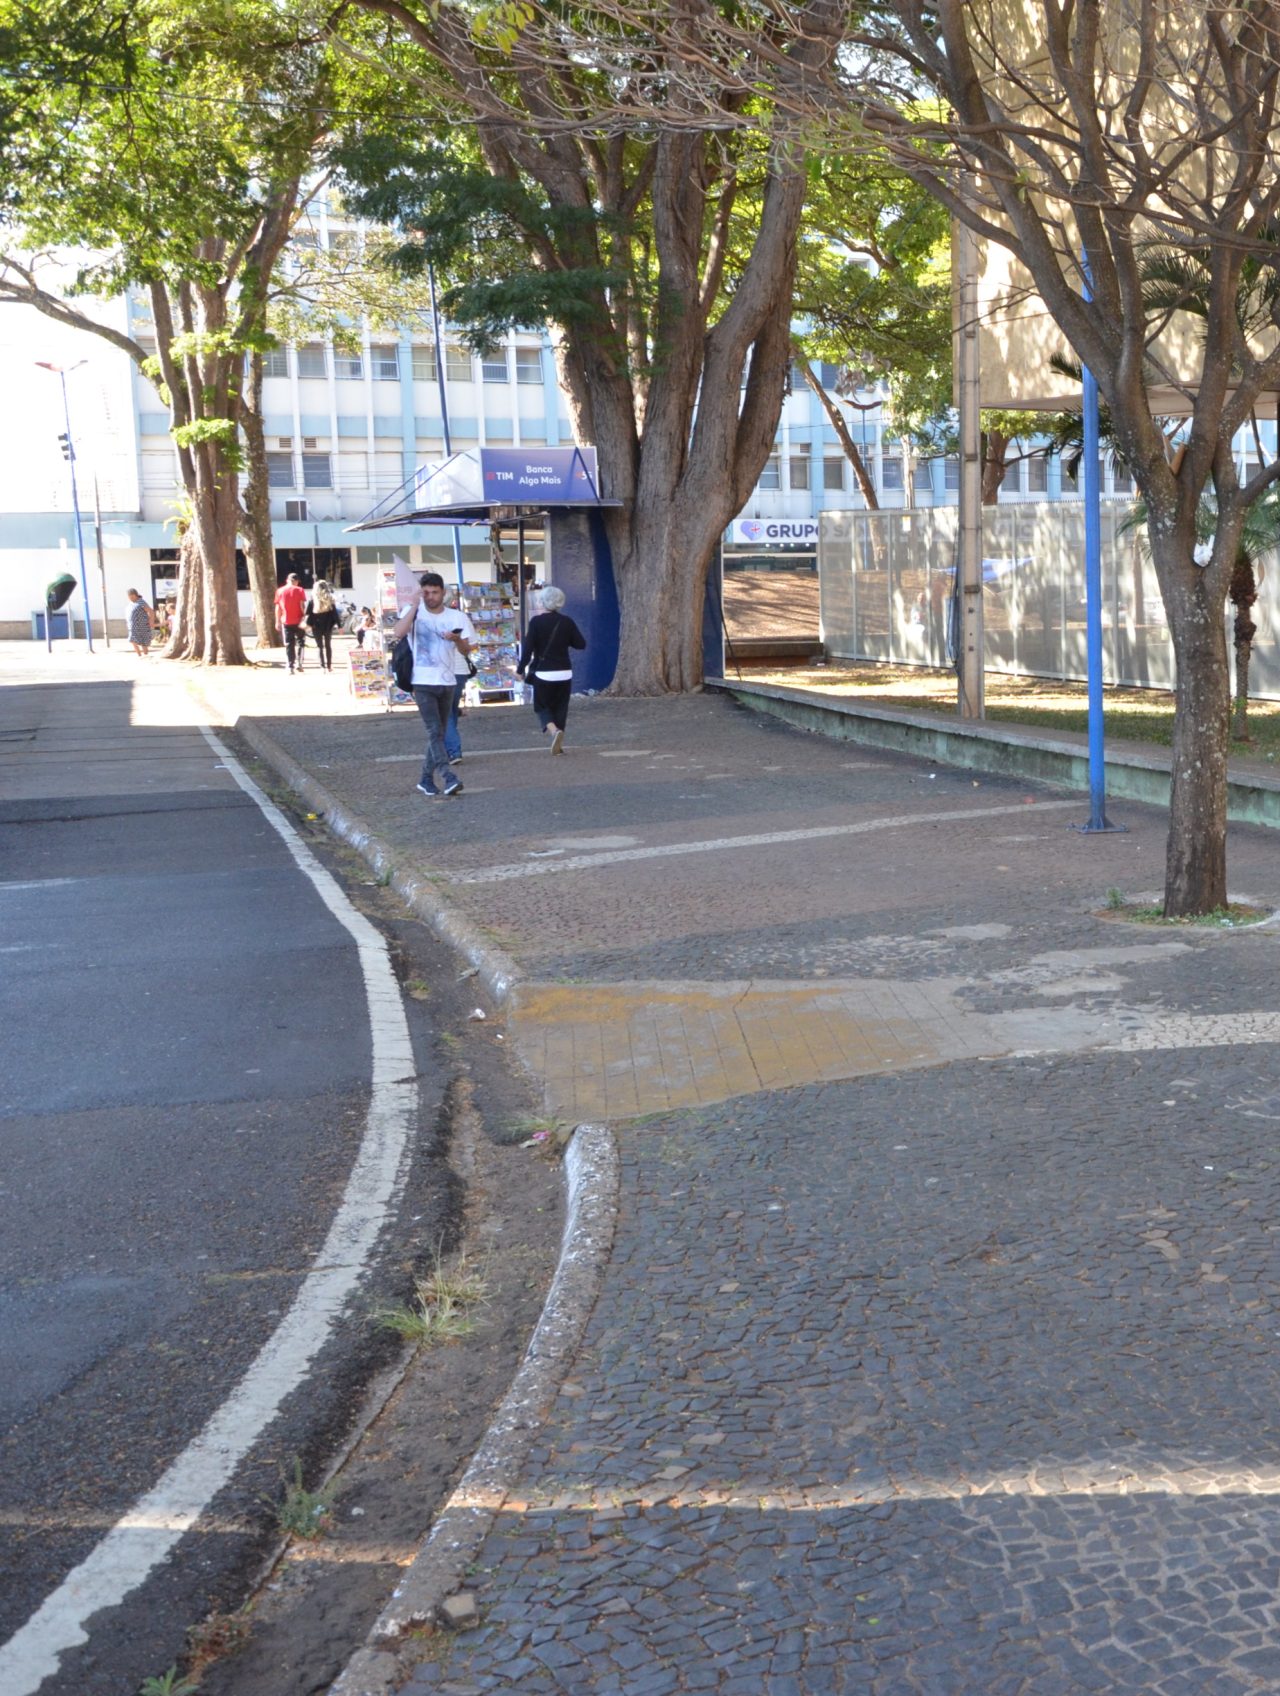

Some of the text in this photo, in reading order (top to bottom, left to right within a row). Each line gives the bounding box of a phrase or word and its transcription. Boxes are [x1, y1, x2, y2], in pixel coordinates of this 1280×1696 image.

[526, 465, 553, 474] Banca
[496, 471, 514, 481] TIM
[519, 476, 562, 487] Algo Mais
[766, 524, 828, 538] GRUPO
